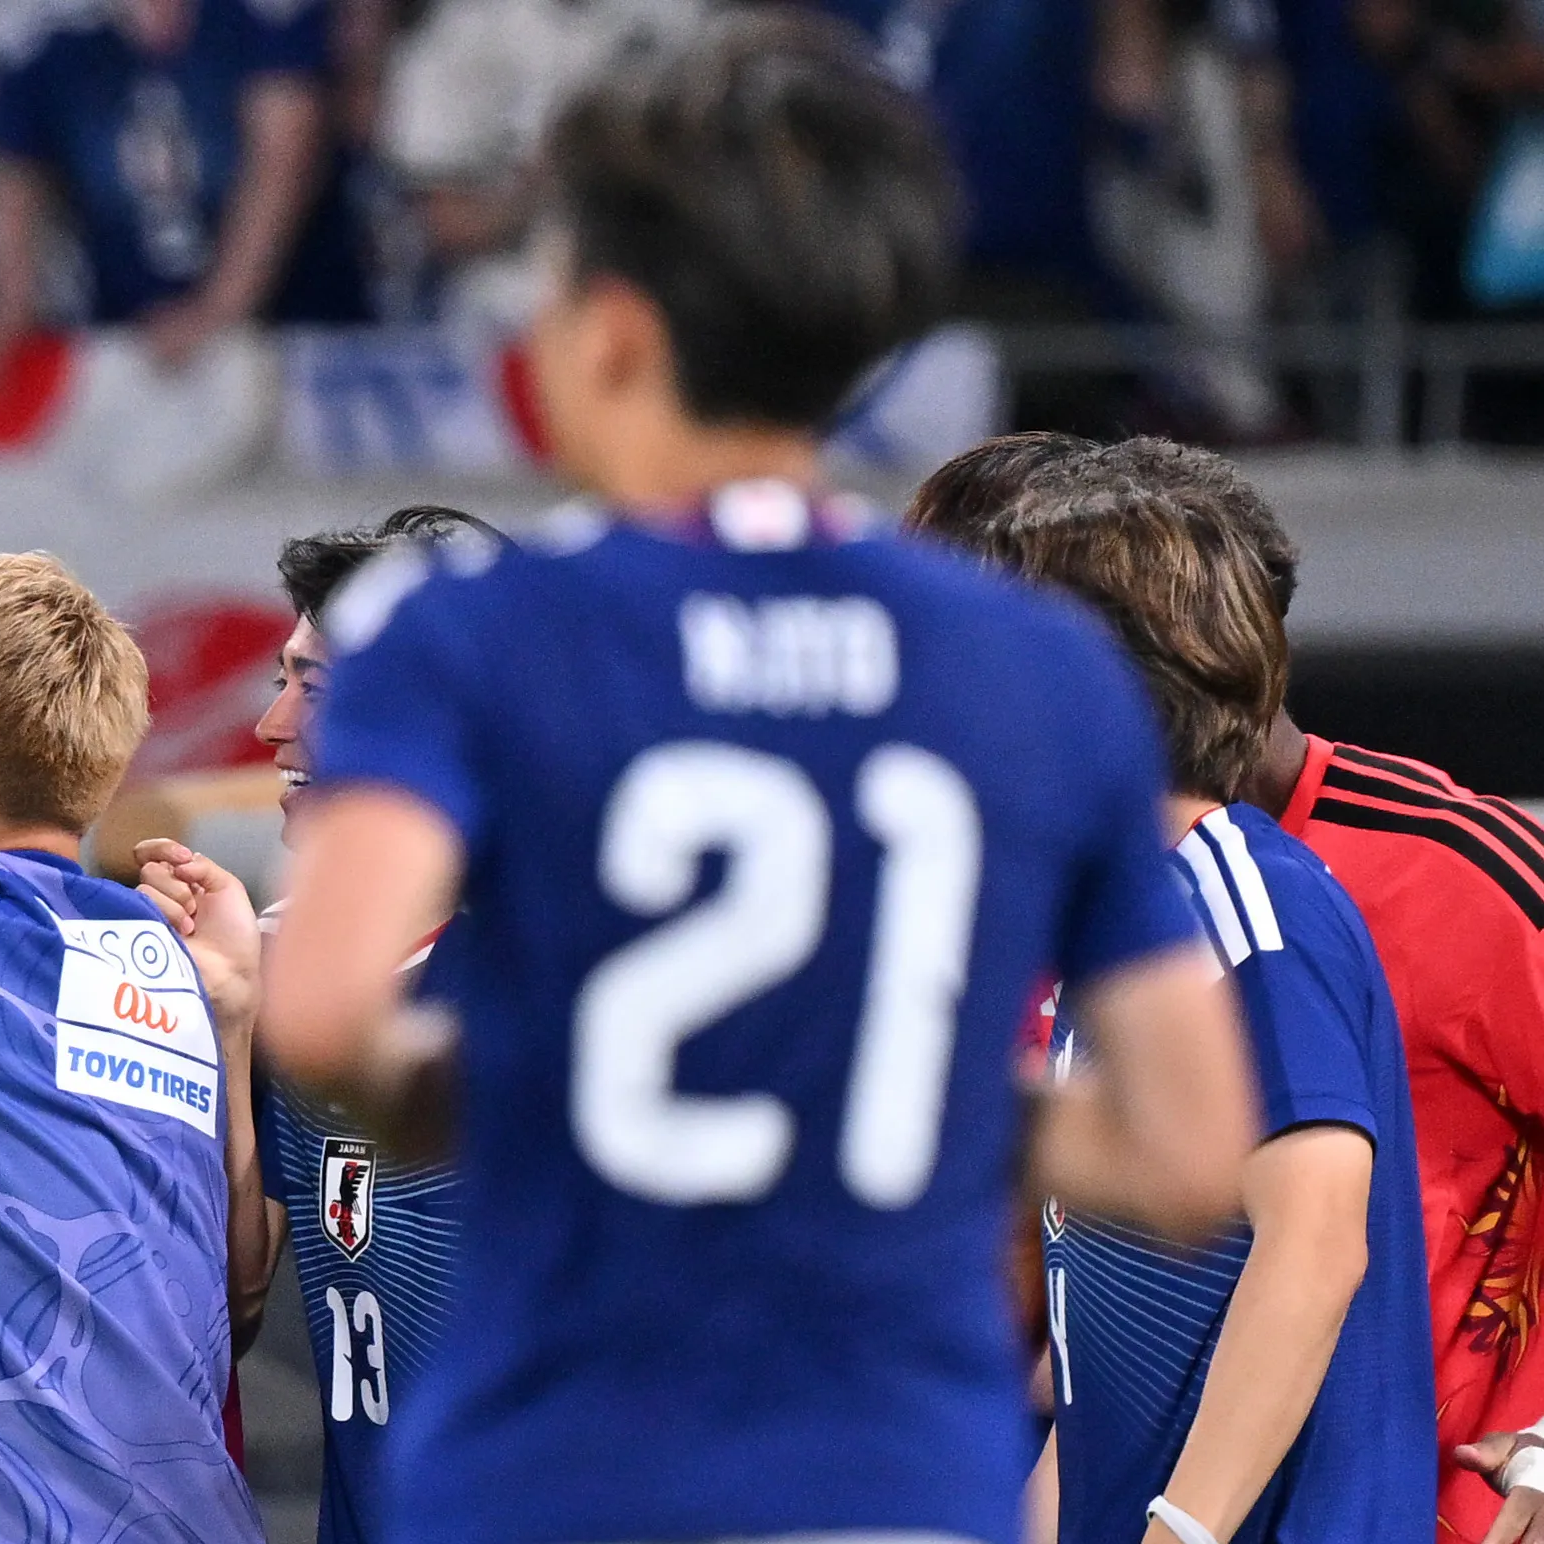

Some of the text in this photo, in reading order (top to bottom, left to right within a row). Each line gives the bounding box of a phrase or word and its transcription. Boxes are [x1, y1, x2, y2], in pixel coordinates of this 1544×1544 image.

[569, 738, 984, 1211] 21
[113, 982, 178, 1034] au
[68, 1046, 212, 1104] TOYO TIRES
[337, 1143, 367, 1155] JAPAN
[326, 1286, 389, 1426] 13
